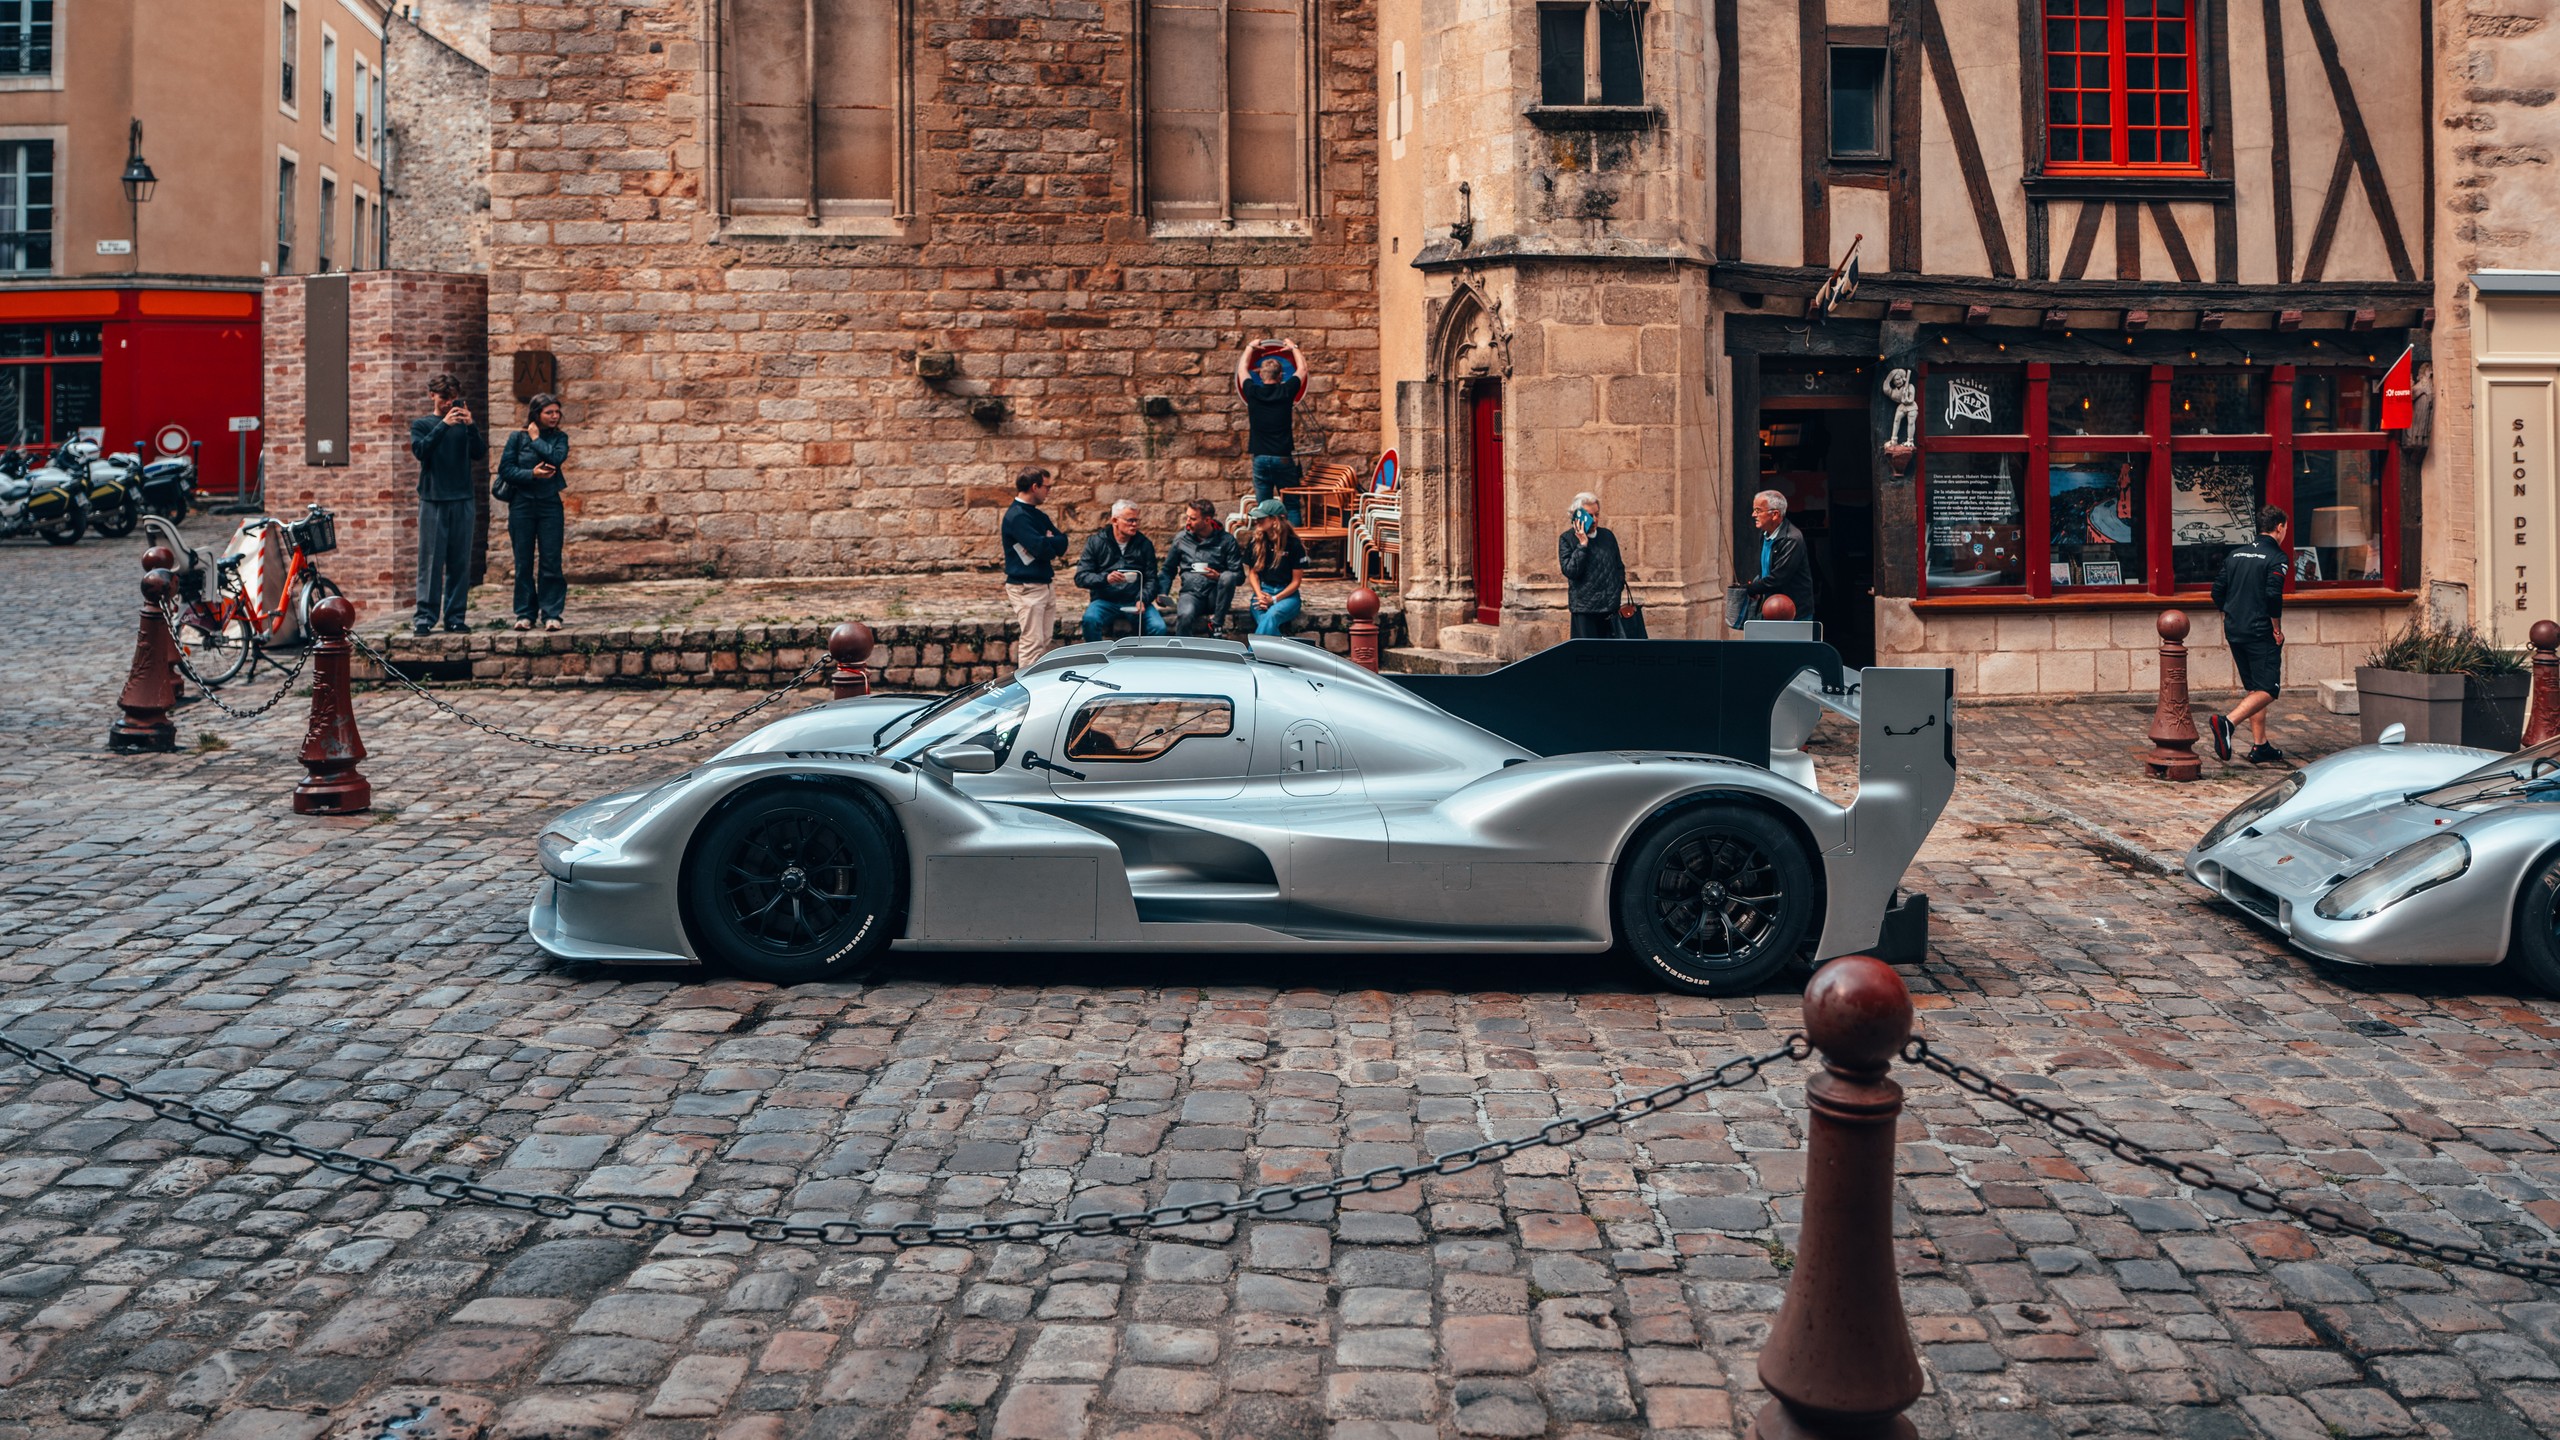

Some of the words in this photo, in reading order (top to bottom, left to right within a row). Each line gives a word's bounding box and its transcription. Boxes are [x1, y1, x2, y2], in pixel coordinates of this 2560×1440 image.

[1955, 377, 1988, 391] atelier
[2395, 389, 2411, 397] course
[2512, 418, 2526, 497] SALON
[2514, 516, 2527, 546] DE
[2515, 565, 2528, 611] THÉ
[1575, 654, 1717, 667] PORSCHE
[826, 914, 874, 964] MICHELIN
[1653, 955, 1710, 986] MICHELIN
